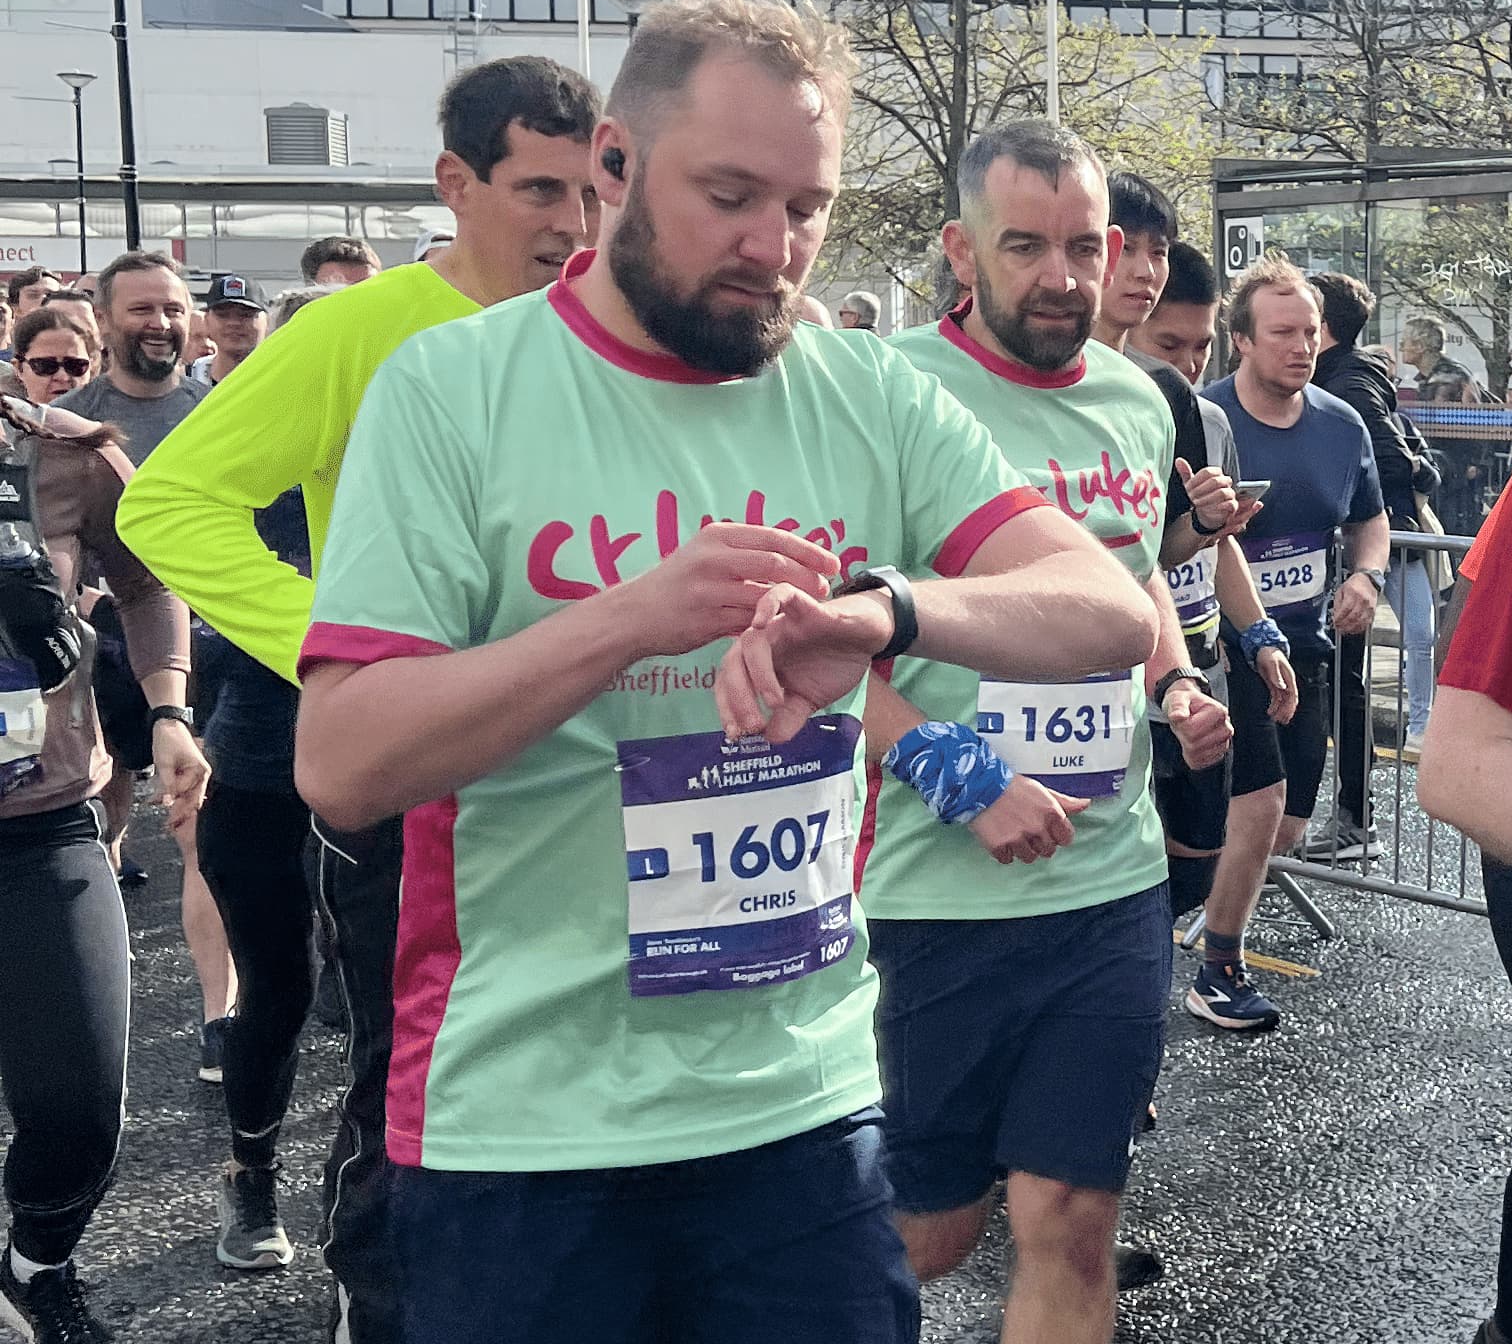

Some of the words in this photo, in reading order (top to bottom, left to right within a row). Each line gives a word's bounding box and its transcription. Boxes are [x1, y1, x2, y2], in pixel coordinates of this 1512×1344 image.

[1048, 451, 1160, 527] Luke's
[1260, 564, 1313, 592] 5428
[604, 664, 716, 697] Sheffield
[1022, 705, 1111, 743] 1631
[722, 754, 783, 774] SHEFFIELD
[722, 772, 755, 788] HALF
[757, 760, 822, 783] MARATHON
[1052, 755, 1085, 768] LUKE
[692, 810, 831, 883] 1607
[739, 889, 797, 914] CHRIS
[674, 942, 698, 955] FOR
[700, 940, 721, 953] ALL
[819, 936, 849, 963] 1607
